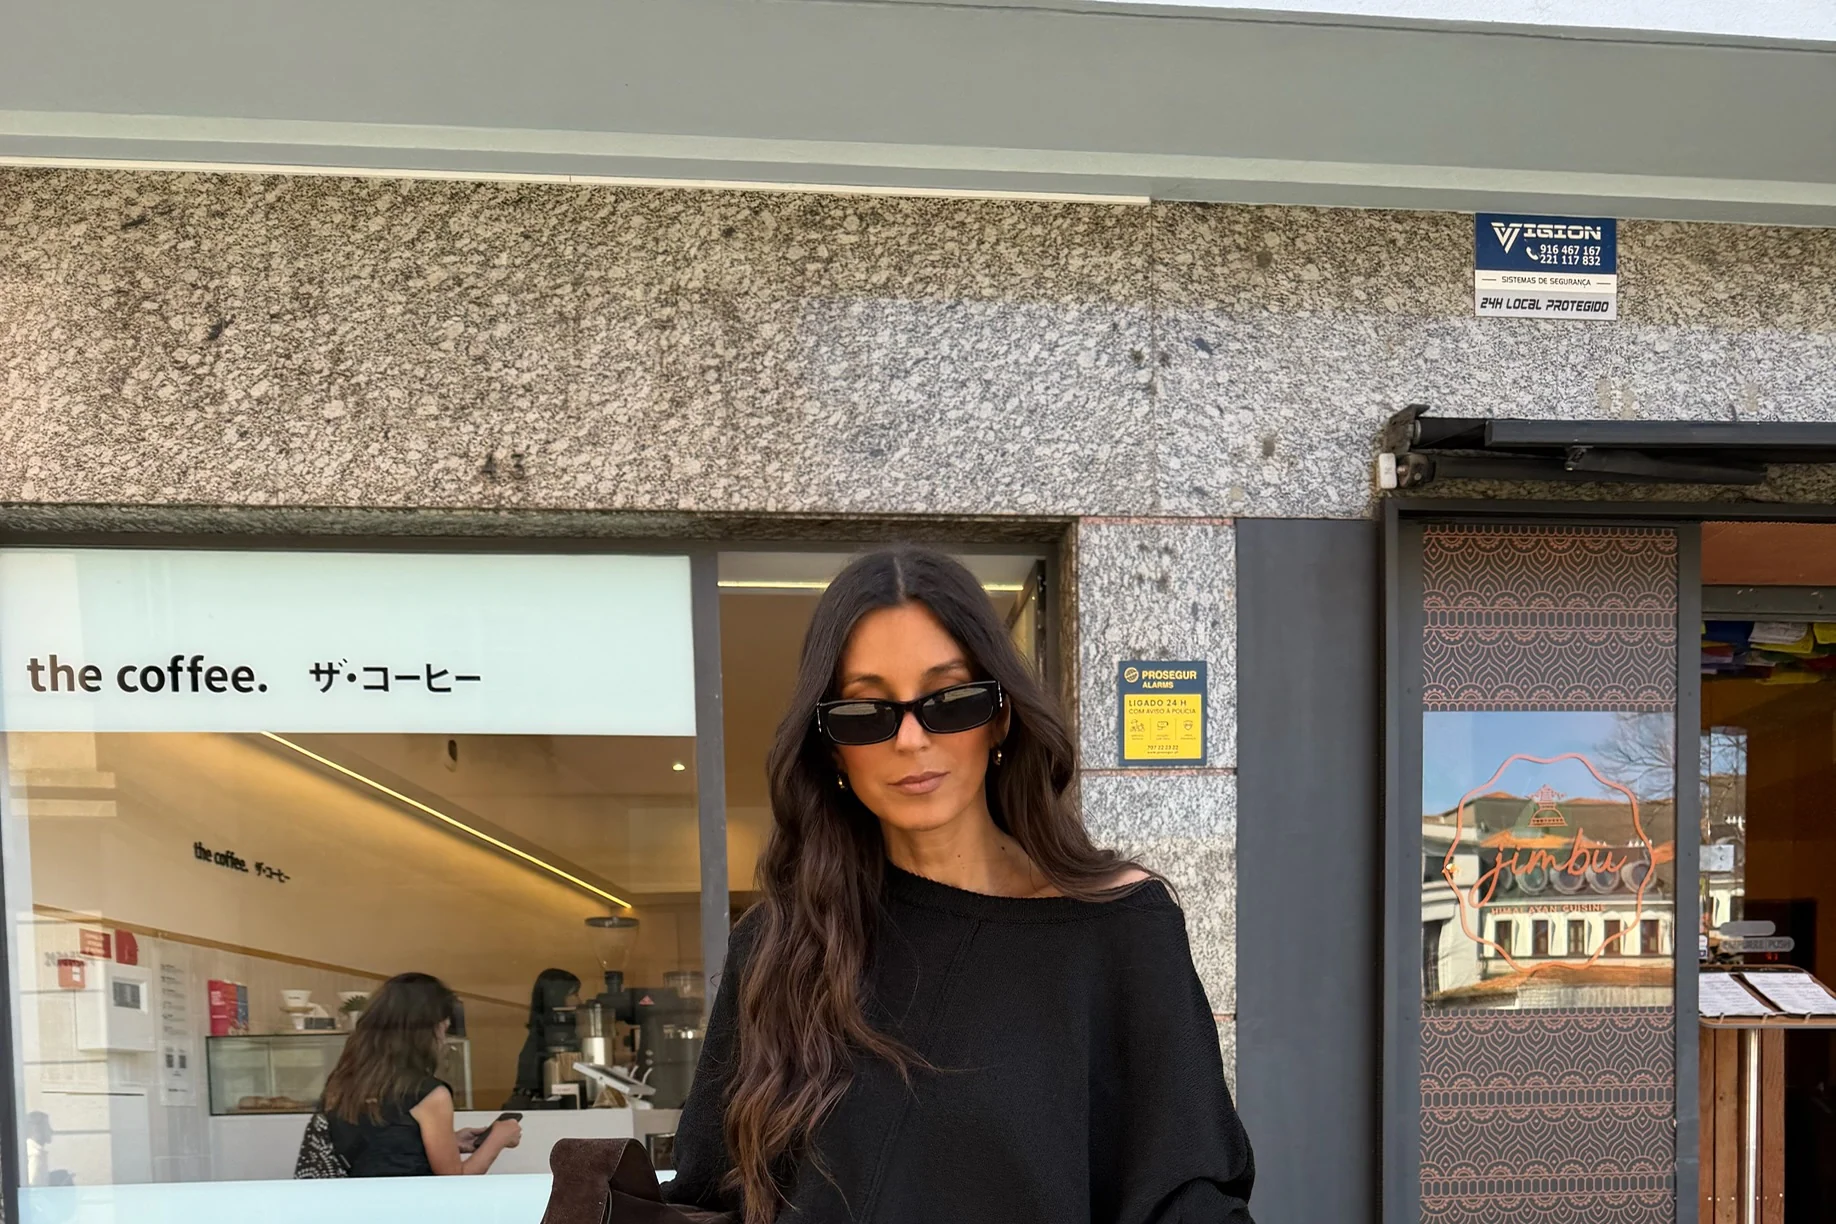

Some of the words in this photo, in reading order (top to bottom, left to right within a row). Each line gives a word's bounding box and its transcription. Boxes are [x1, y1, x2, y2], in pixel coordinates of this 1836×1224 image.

[1540, 244, 1559, 254] 916
[1561, 245, 1580, 255] 467
[1583, 246, 1601, 256] 167
[1540, 255, 1558, 264] 221
[1561, 255, 1579, 265] 117
[1582, 256, 1601, 266] 832
[1501, 276, 1537, 284] SISTEMAS
[1549, 278, 1591, 288] SEGURANÇA
[1480, 297, 1503, 309] 24H
[1506, 298, 1542, 310] LOCAL
[1545, 299, 1609, 312] PROTEGIDO
[26, 654, 102, 693] the
[116, 654, 268, 694] coffee.
[309, 658, 482, 694] ザ・コーヒー
[1141, 670, 1197, 680] PROSEGUR
[1142, 681, 1174, 689] ALARMS
[1128, 699, 1164, 707] LIGADO
[1166, 699, 1177, 707] 24
[1180, 699, 1187, 707] H
[193, 841, 213, 862] the
[214, 850, 249, 873] coffee.
[1468, 827, 1628, 909] jimbu
[1490, 905, 1558, 915] HIMALAYAN
[1562, 904, 1606, 912] CUISINE
